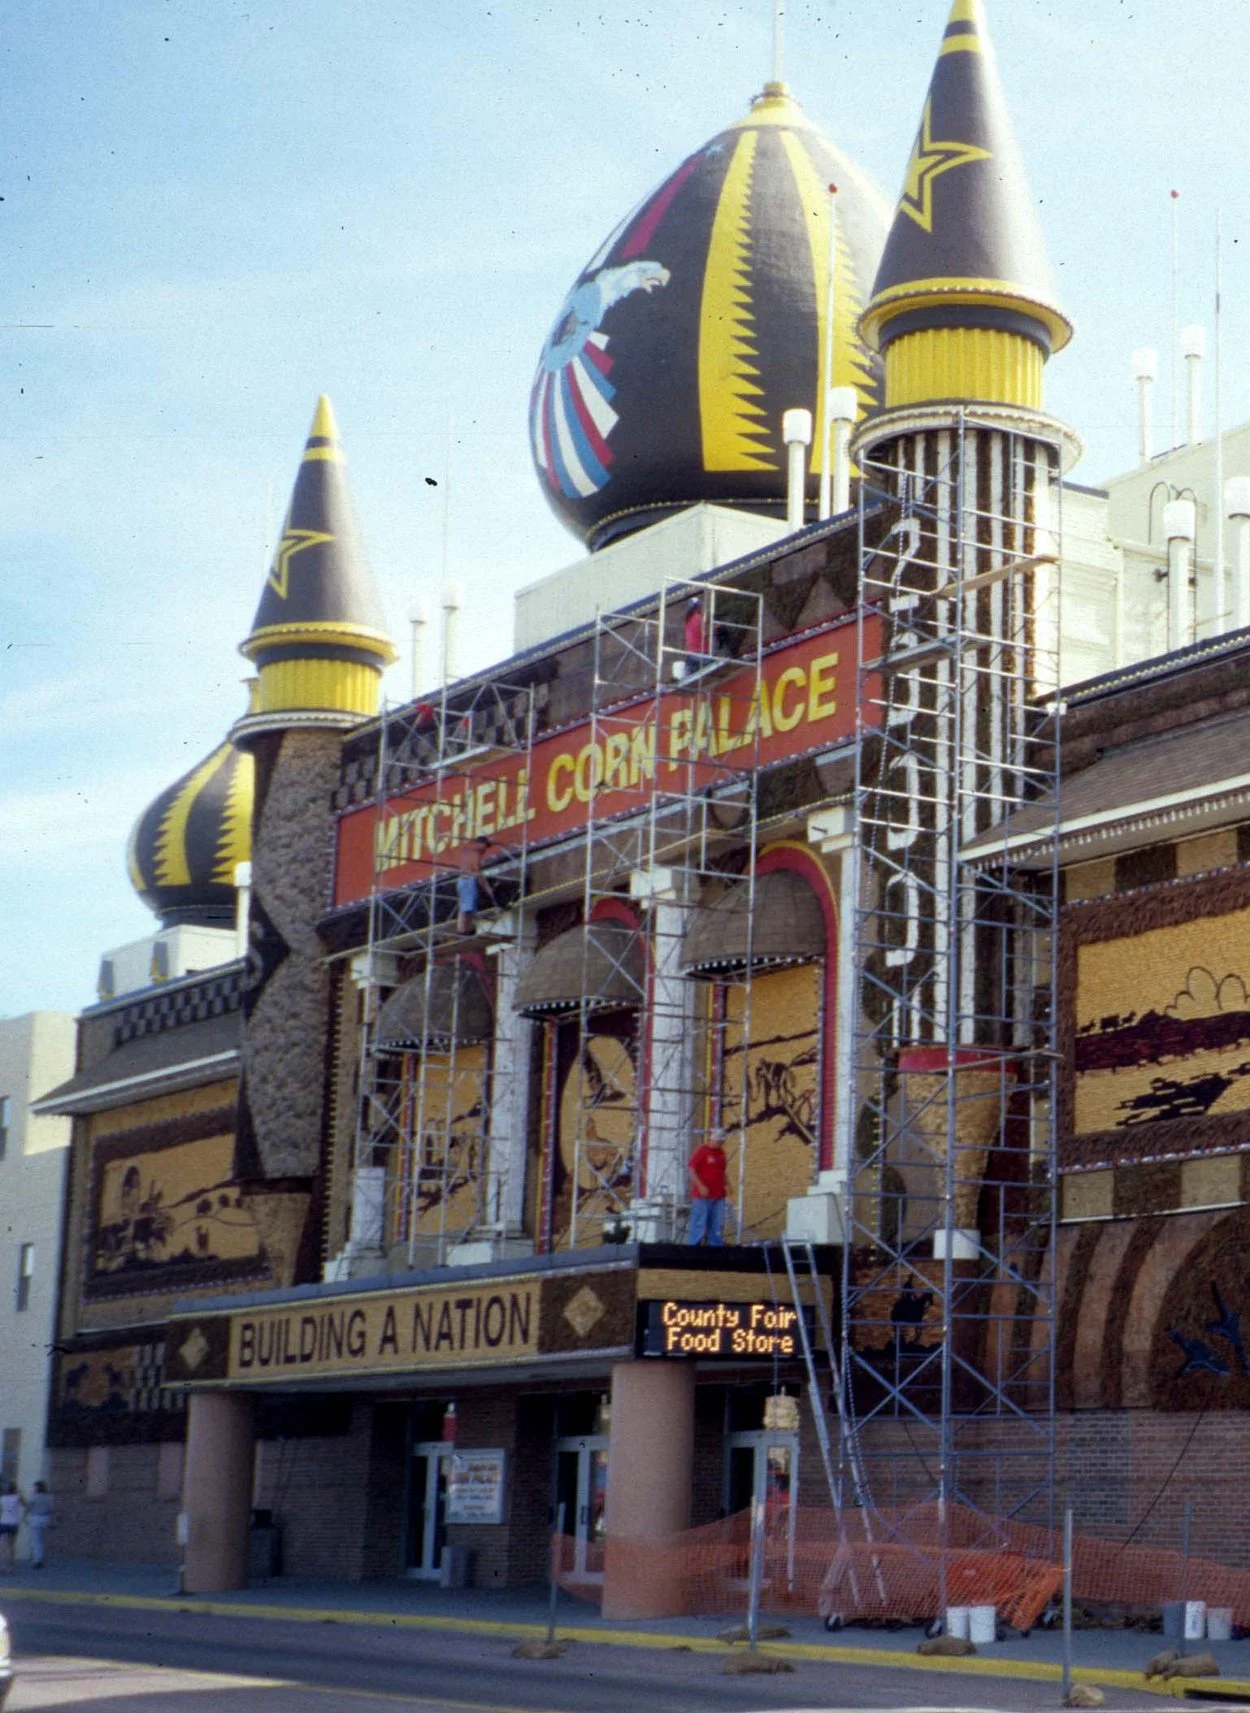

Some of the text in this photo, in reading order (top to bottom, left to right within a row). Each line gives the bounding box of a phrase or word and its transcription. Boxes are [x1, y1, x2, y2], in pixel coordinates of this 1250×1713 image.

[376, 652, 839, 873] MITCHELL CORN PALACE
[238, 1292, 532, 1368] BUILDING A NATION
[663, 1302, 797, 1329] County Fair
[667, 1327, 794, 1353] Food Store
